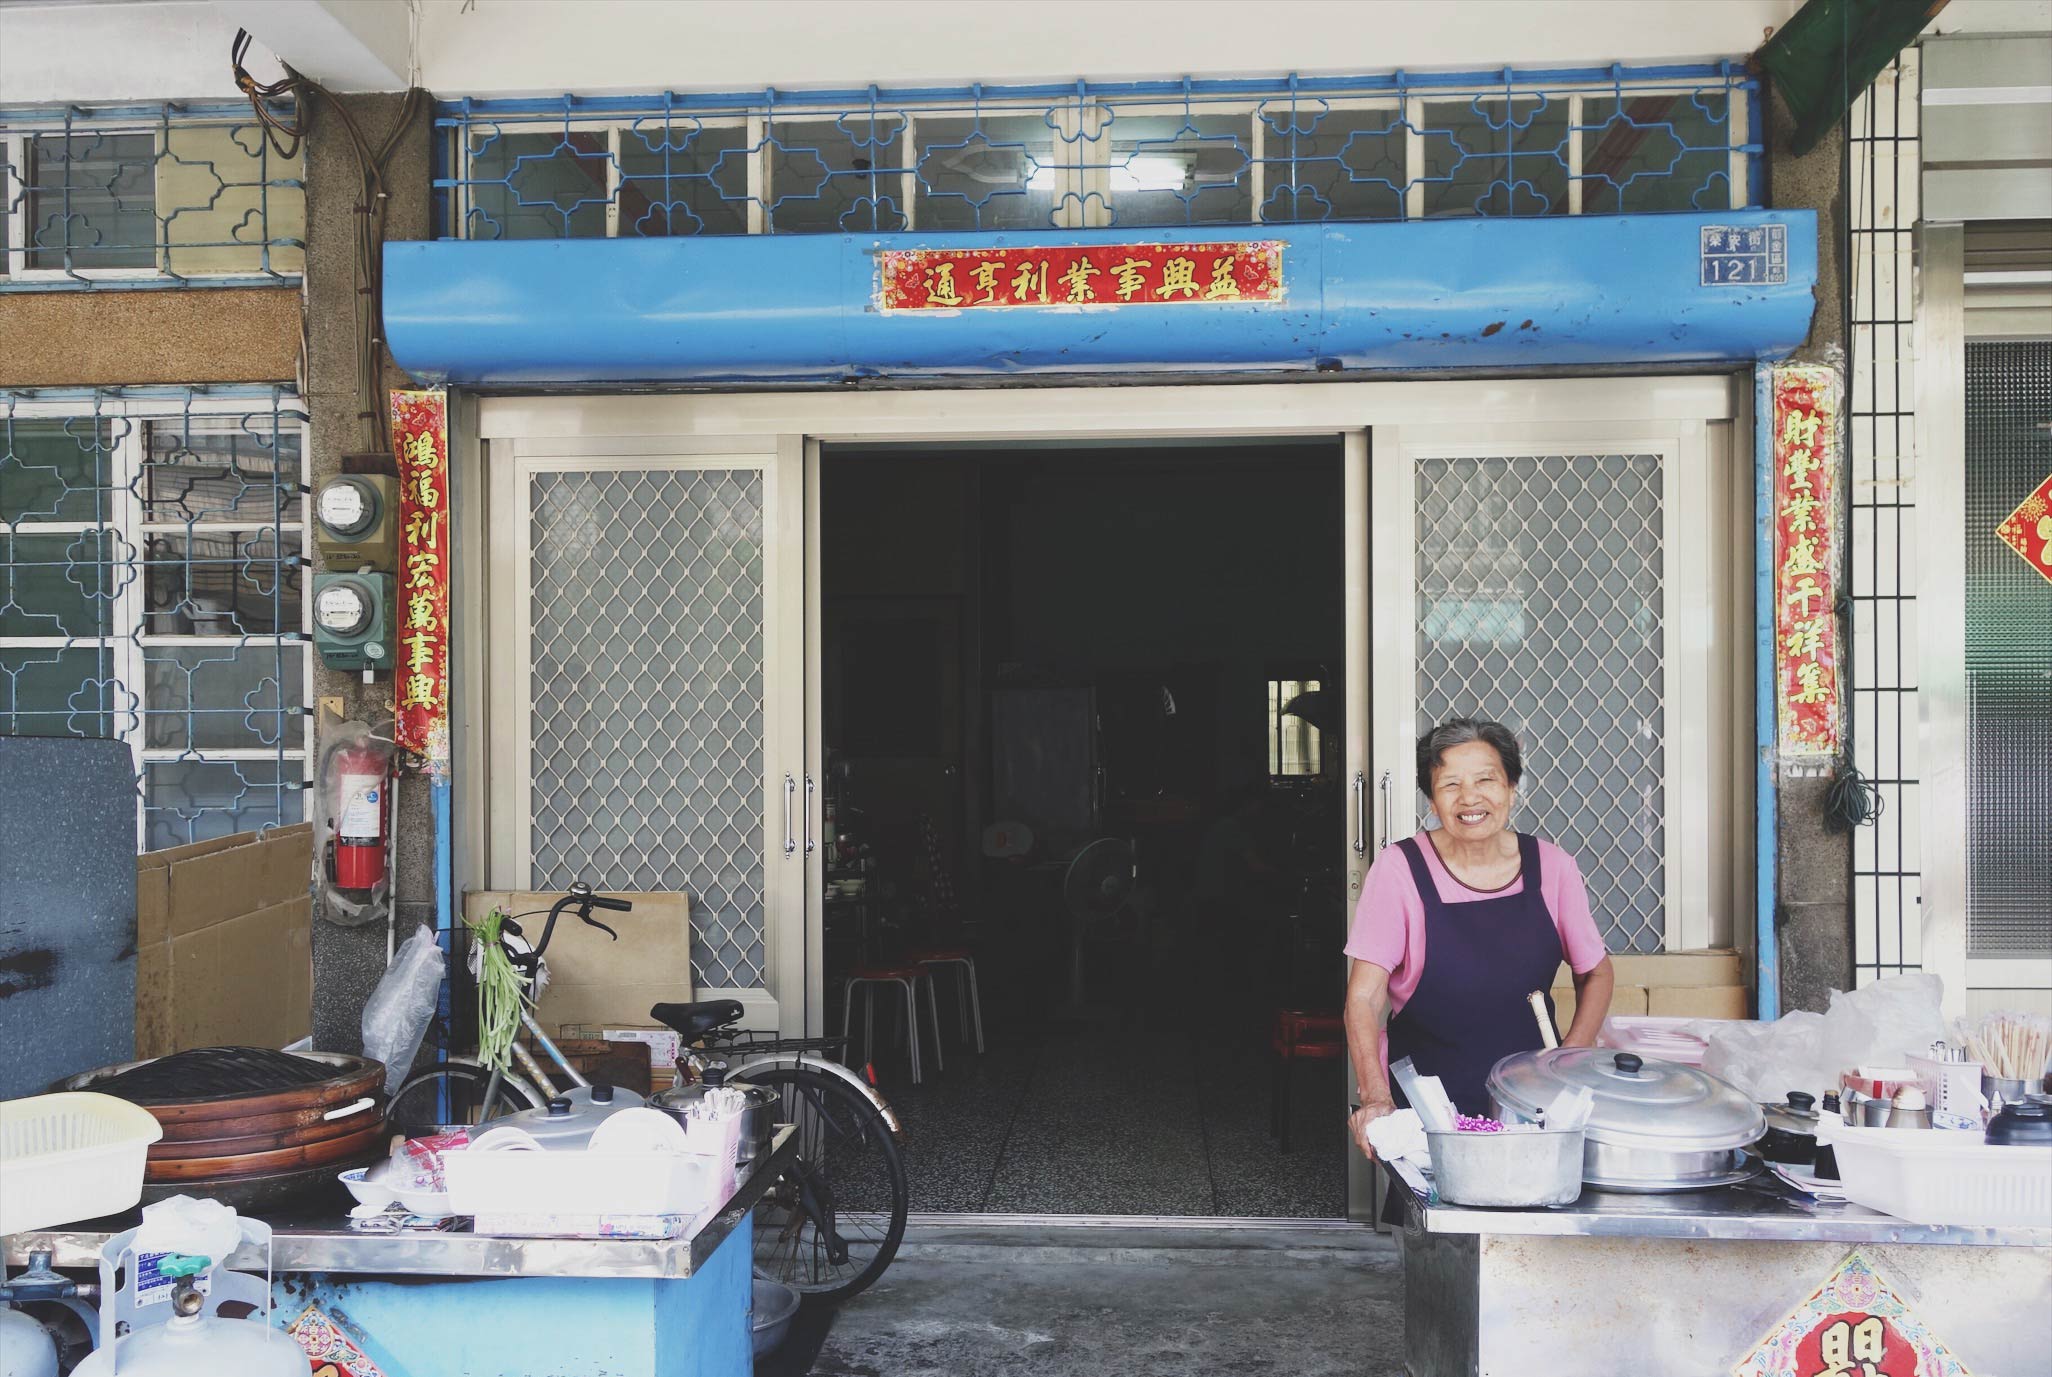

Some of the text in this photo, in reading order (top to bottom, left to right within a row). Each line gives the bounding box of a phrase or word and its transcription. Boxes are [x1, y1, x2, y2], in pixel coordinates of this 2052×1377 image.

[1712, 259, 1755, 281] 121
[402, 431, 440, 711] 鴻福利宏萬事興
